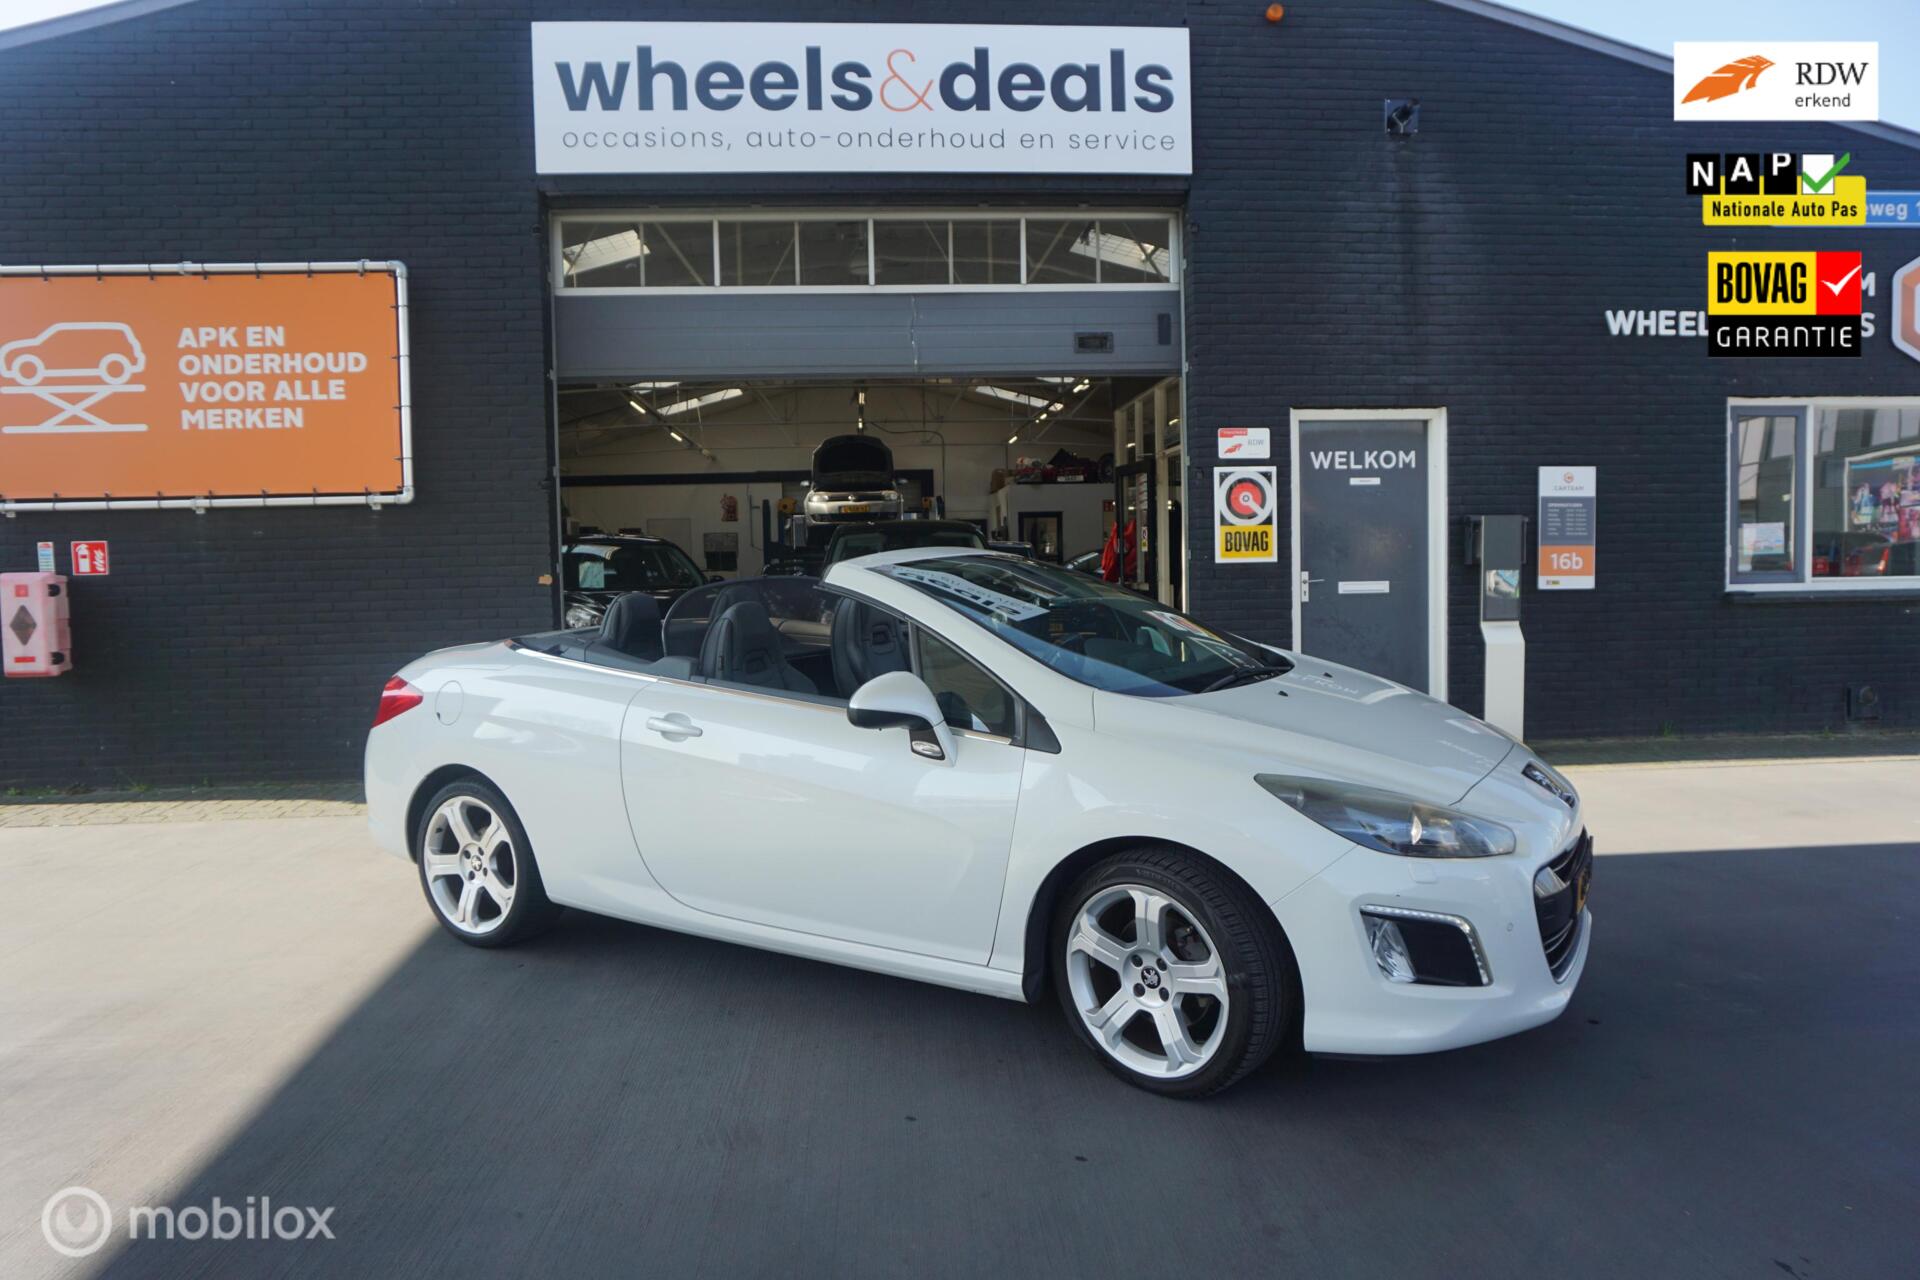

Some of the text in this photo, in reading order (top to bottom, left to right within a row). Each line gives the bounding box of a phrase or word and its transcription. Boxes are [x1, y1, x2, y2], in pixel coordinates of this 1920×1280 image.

[554, 45, 1175, 113] wheels&deals
[562, 127, 1175, 151] occasions, auto-onderhoud en service
[1866, 203, 1908, 221] weg
[1605, 309, 1709, 336] WHEEL
[177, 325, 285, 349] APK EN
[178, 352, 368, 376] ONDERHOUD
[179, 379, 346, 403] VOOR ALLE
[180, 407, 304, 430] MERKEN
[1309, 450, 1416, 470] WELKOM
[1224, 531, 1269, 553] BOVAG
[1551, 552, 1584, 570] 16b
